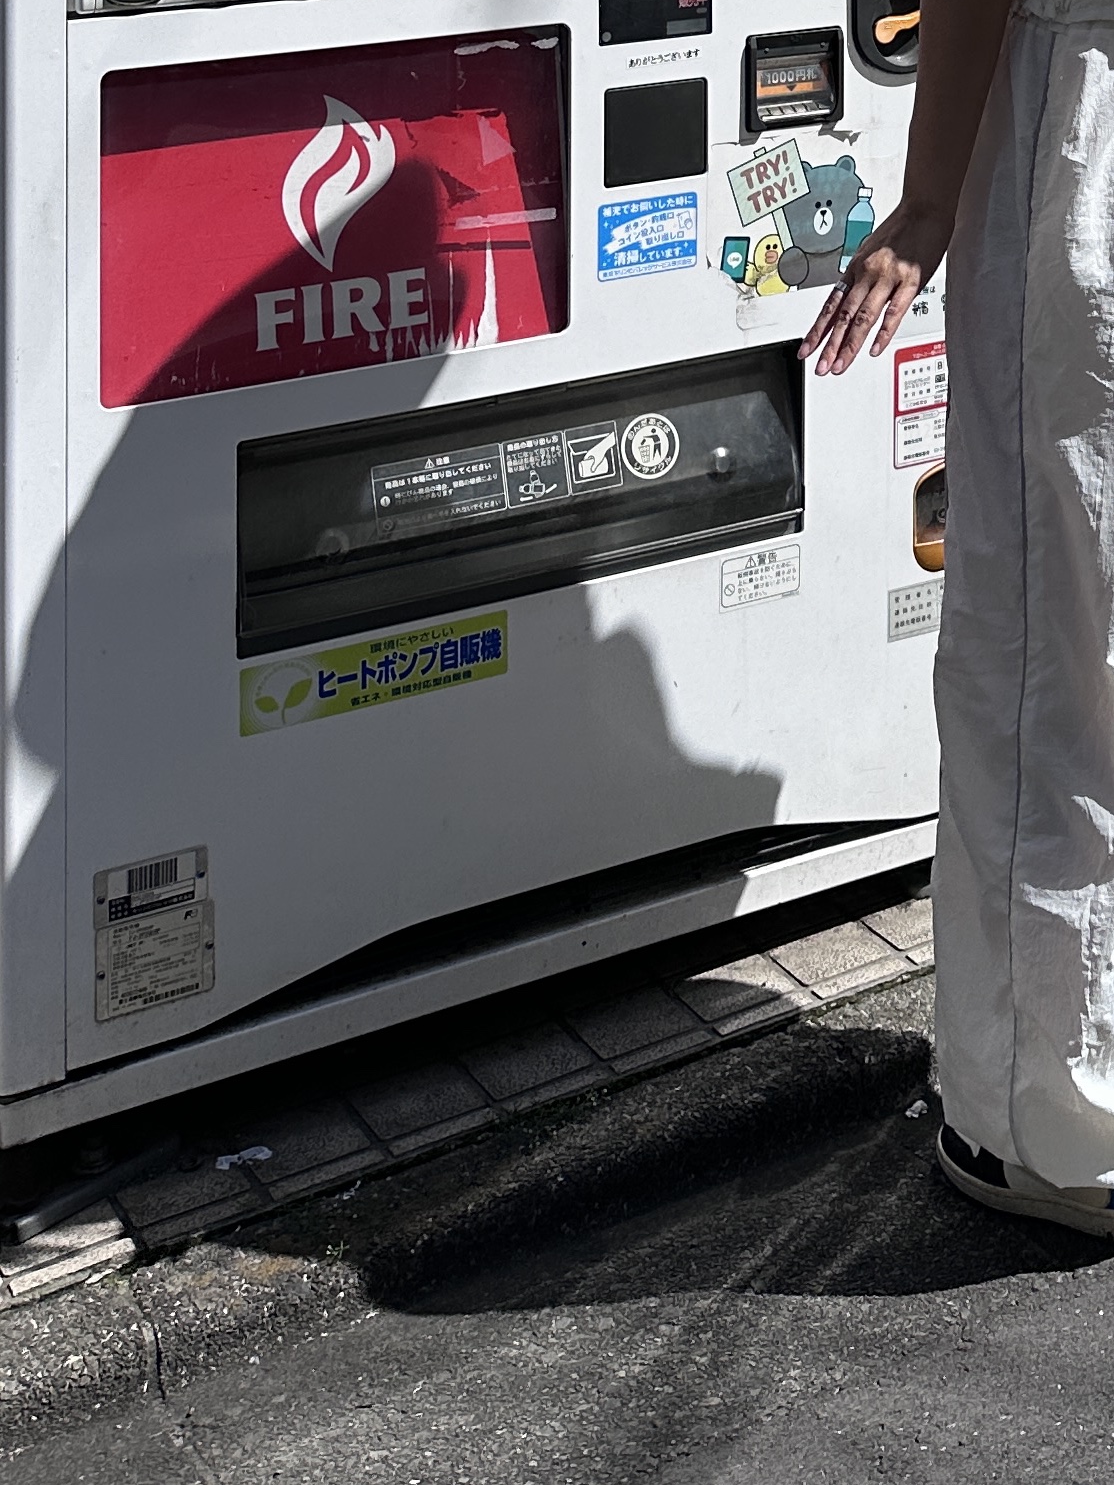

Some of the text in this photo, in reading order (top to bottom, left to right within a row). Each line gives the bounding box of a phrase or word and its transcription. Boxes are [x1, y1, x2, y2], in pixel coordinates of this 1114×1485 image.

[628, 48, 701, 69] ありがとうございます
[740, 151, 791, 188] TRY!
[746, 176, 799, 215] TRY!
[618, 225, 664, 246] コイン投入口
[254, 266, 429, 352] FIRE
[369, 626, 455, 654] 環境にやさしい
[318, 628, 503, 699] ヒートポンプ自販機
